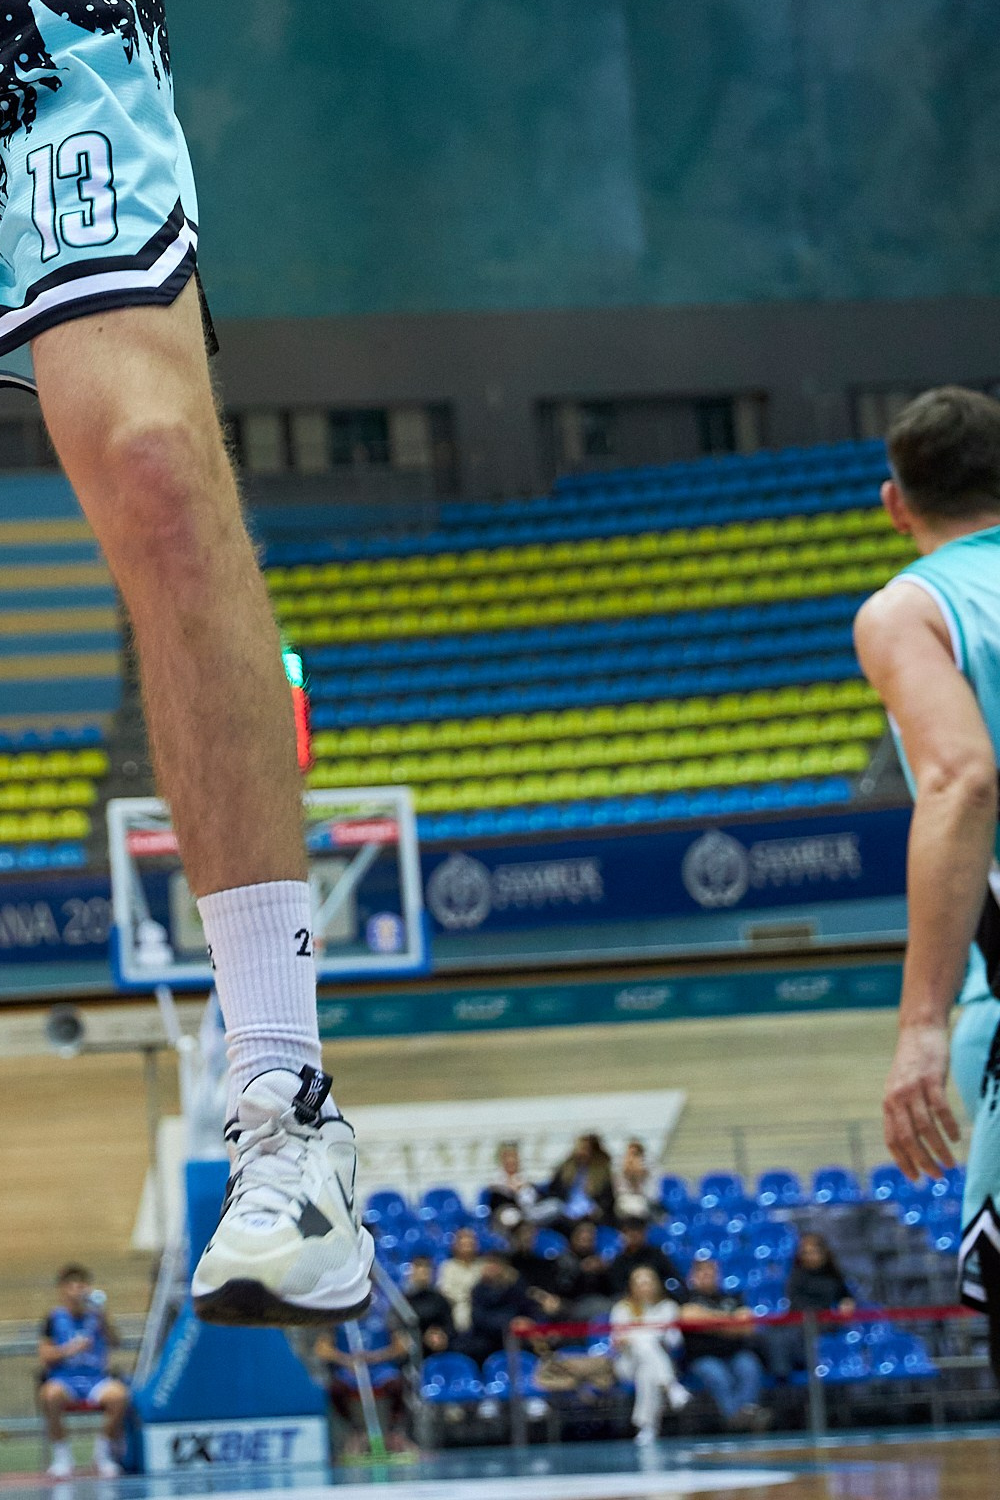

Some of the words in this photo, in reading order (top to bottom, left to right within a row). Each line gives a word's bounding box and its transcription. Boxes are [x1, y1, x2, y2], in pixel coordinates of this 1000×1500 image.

[27, 130, 118, 262] 13
[62, 897, 113, 946] 20
[294, 928, 313, 958] 2
